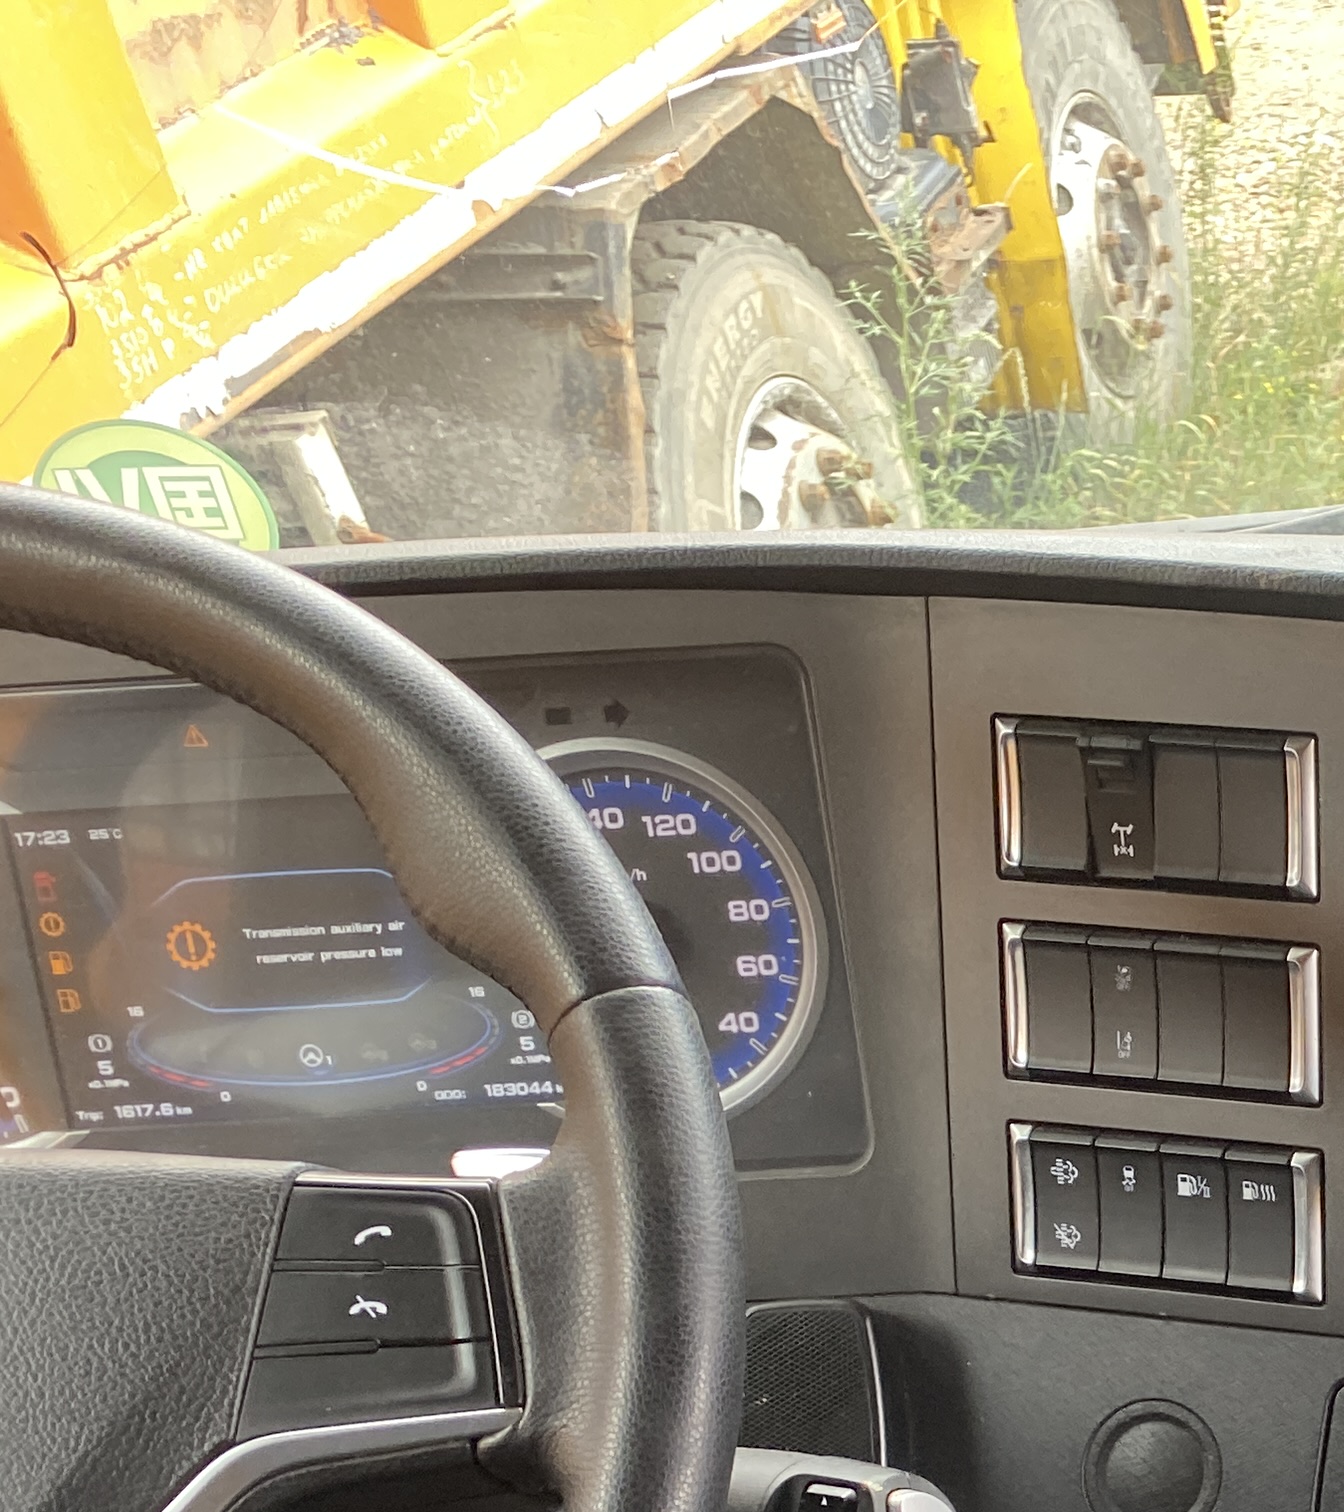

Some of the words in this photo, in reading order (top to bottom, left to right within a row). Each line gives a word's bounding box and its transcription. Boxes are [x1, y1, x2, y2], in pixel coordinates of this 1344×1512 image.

[588, 807, 625, 830] 40
[641, 813, 697, 838] 120
[14, 829, 71, 847] 17:23
[686, 850, 742, 874] 100
[727, 899, 770, 923] 80
[242, 925, 326, 940] Transmission
[330, 922, 383, 935] auxiliary
[387, 920, 406, 932] air
[256, 951, 315, 965] reservoir
[320, 948, 376, 963] pressure
[380, 946, 403, 957] low
[736, 954, 779, 977] 60
[468, 985, 486, 998] 16
[718, 1011, 760, 1034] 40
[519, 1036, 536, 1051] 5
[97, 1060, 115, 1076] 5
[483, 1080, 553, 1097] 183044
[113, 1102, 174, 1119] 1617.6
